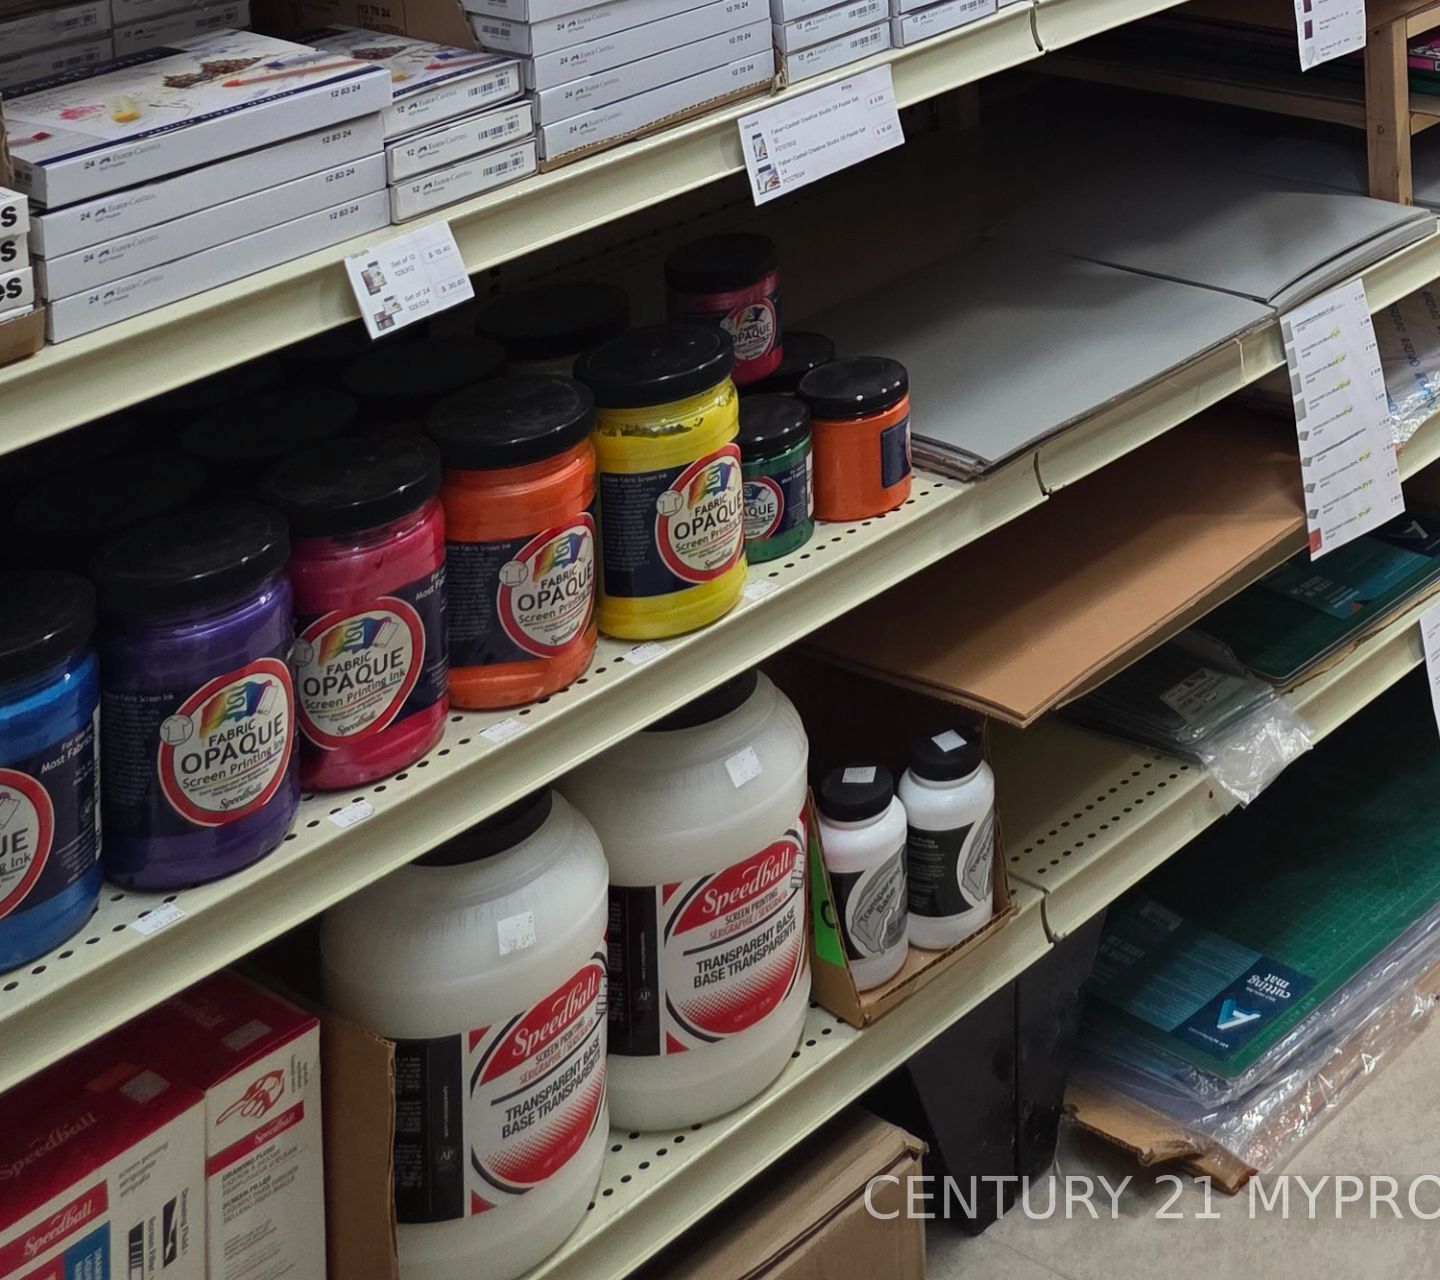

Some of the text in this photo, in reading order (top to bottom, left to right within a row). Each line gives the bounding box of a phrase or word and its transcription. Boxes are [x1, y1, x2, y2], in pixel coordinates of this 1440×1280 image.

[674, 489, 743, 540] OPAQUE
[695, 493, 727, 517] FABRIC
[517, 559, 593, 612] OPAQUE
[540, 566, 578, 590] FABRIC
[303, 646, 404, 697] OPAQUE
[326, 650, 372, 676] FABRIC
[304, 667, 406, 710] Screen Printing Ink
[208, 718, 256, 747] FABRIC
[336, 709, 376, 736] Speedball
[181, 712, 284, 775] OPAQUE
[41, 757, 65, 775] Most
[182, 769, 227, 791] Screen
[229, 749, 272, 774] Printing
[218, 782, 263, 811] Speedball
[11, 852, 32, 868] Ink
[701, 845, 792, 917] Speedball
[724, 906, 751, 926] SCREEN
[693, 919, 797, 990] BASE TRANSPARENTE
[696, 906, 796, 974] TRANSPARENT BASE
[1246, 973, 1292, 1001] cutting
[1263, 972, 1291, 989] mat
[511, 971, 598, 1058] Speedball
[504, 1035, 601, 1123] TRANSPARENT BASE
[501, 1111, 537, 1140] BASE
[22, 1198, 95, 1258] Speedball
